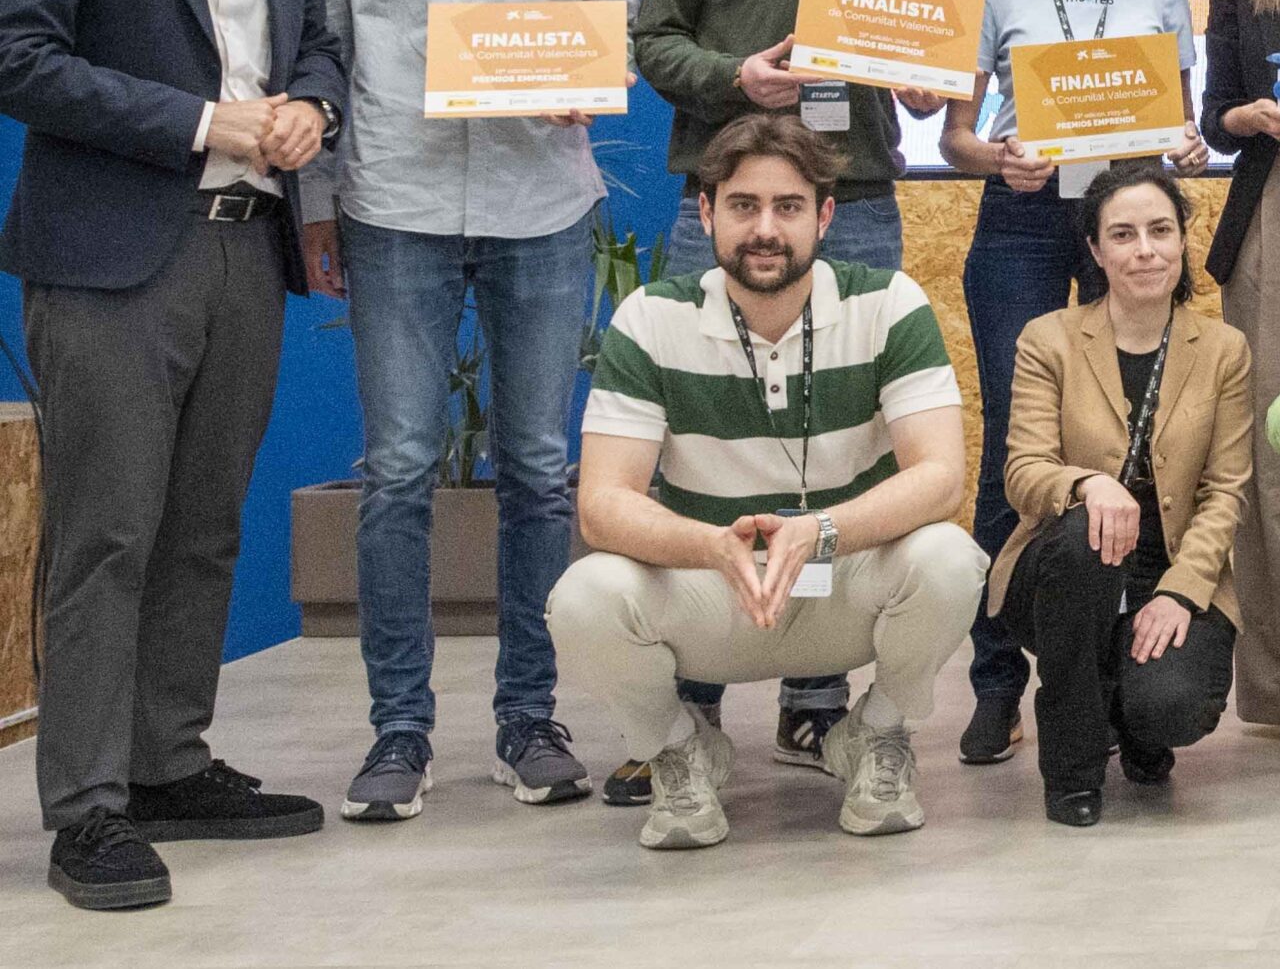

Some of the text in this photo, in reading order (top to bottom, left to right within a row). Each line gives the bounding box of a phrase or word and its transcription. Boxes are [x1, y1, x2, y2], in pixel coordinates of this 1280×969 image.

[828, 7, 955, 37] de Comunitat Valenciana
[471, 31, 586, 48] FINALISTA
[476, 49, 534, 60] Comunitat
[537, 48, 599, 59] Valenciana
[1050, 69, 1148, 93] FINALISTA
[1041, 87, 1158, 107] de Comunitat Valenciana
